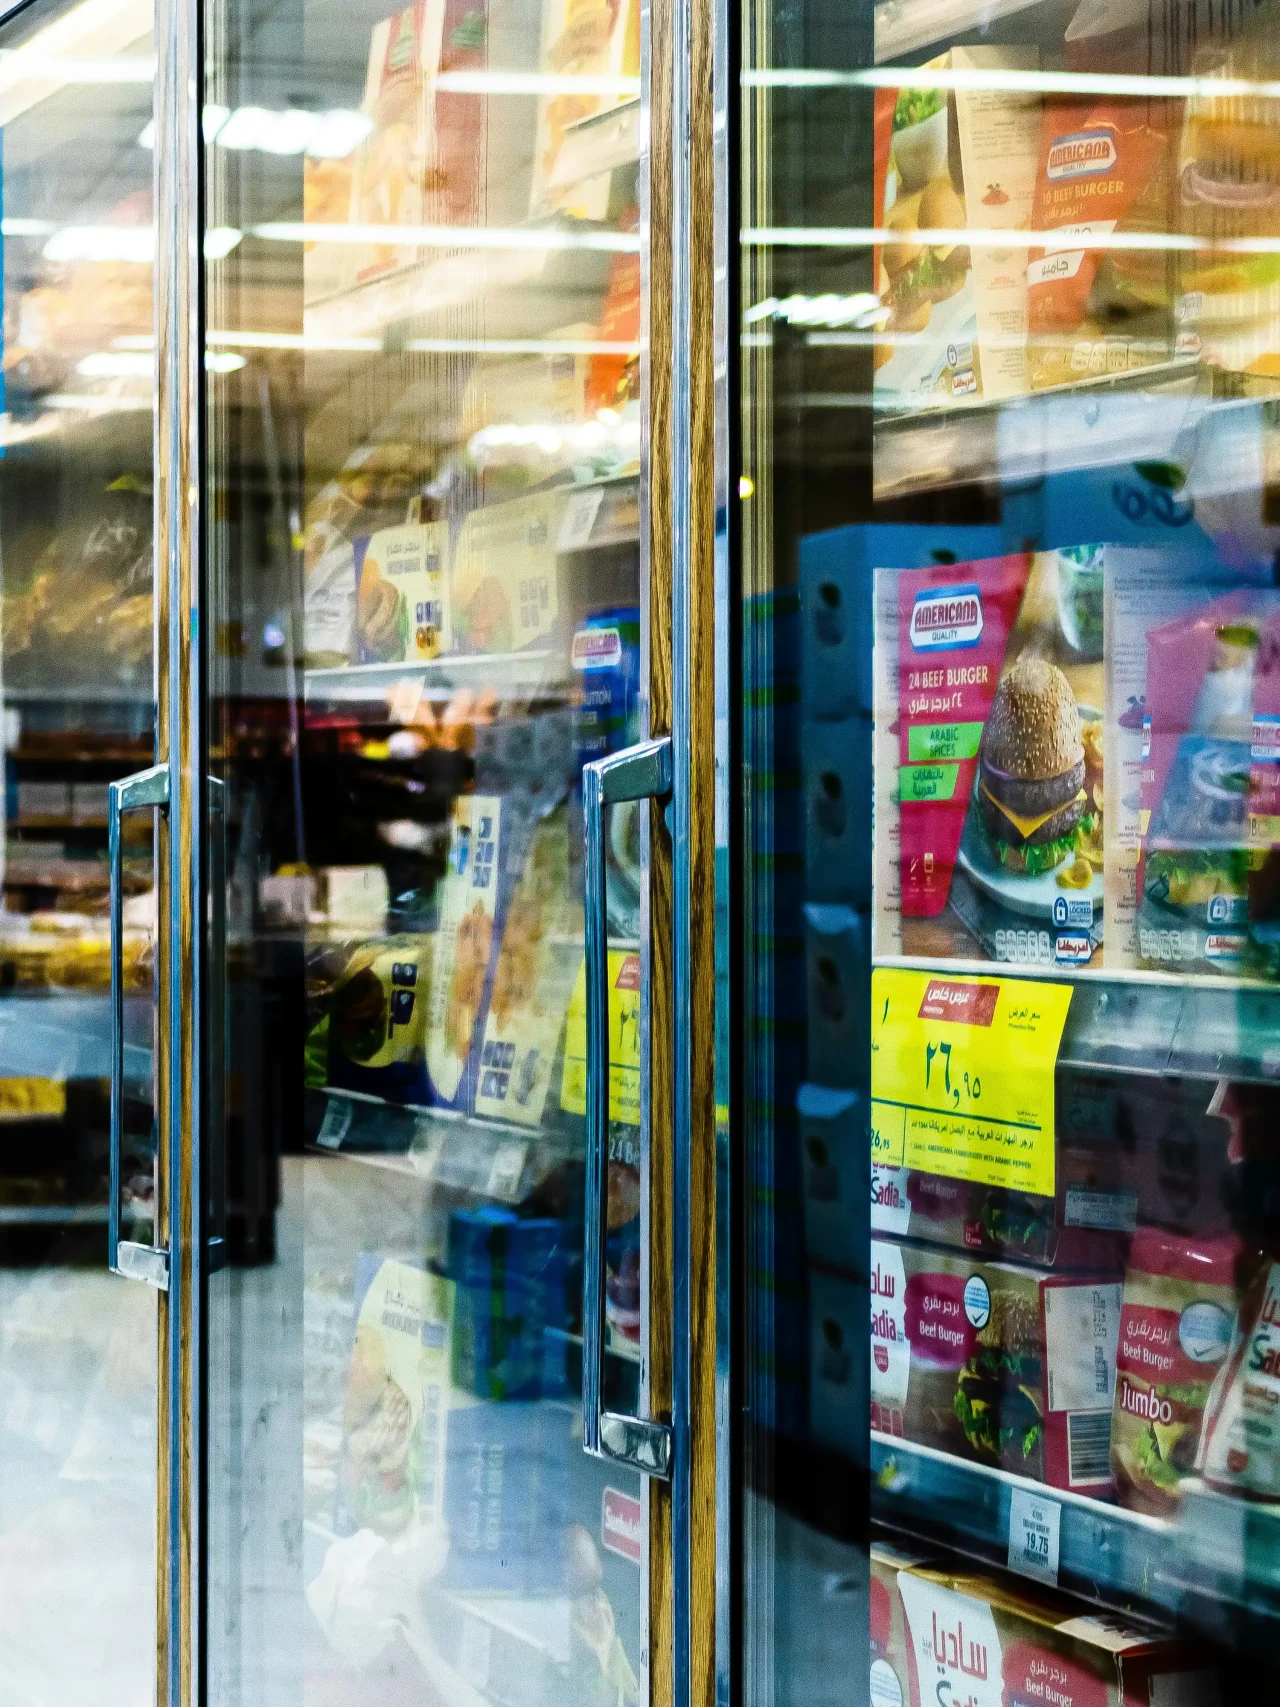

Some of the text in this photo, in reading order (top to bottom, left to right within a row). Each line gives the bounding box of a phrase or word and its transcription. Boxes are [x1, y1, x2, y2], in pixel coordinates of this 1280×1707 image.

[1054, 187, 1073, 202] BEEF
[1075, 180, 1124, 198] BURGER
[1041, 258, 1069, 277] جامبو
[915, 600, 978, 629] AMERICANA
[931, 630, 958, 641] QUALITY
[922, 669, 945, 689] BEEF
[947, 665, 988, 687] BURGER
[929, 727, 959, 742] ARABIC
[929, 743, 956, 758] SPICES
[927, 986, 970, 1006] عرض خاص
[871, 1176, 901, 1209] Sadia
[923, 1296, 960, 1317] برجر بقري
[871, 1309, 897, 1341] adia
[919, 1320, 965, 1347] Beef Burger
[1126, 1319, 1171, 1346] برجر بقري
[1123, 1341, 1174, 1371] Beef Burger
[1121, 1380, 1173, 1422] Jumbo
[1026, 1531, 1049, 1554] 19.75
[932, 1611, 988, 1682] ساديا
[1029, 1659, 1067, 1686] برجر بقري
[1025, 1677, 1073, 1707] Beef Burger
